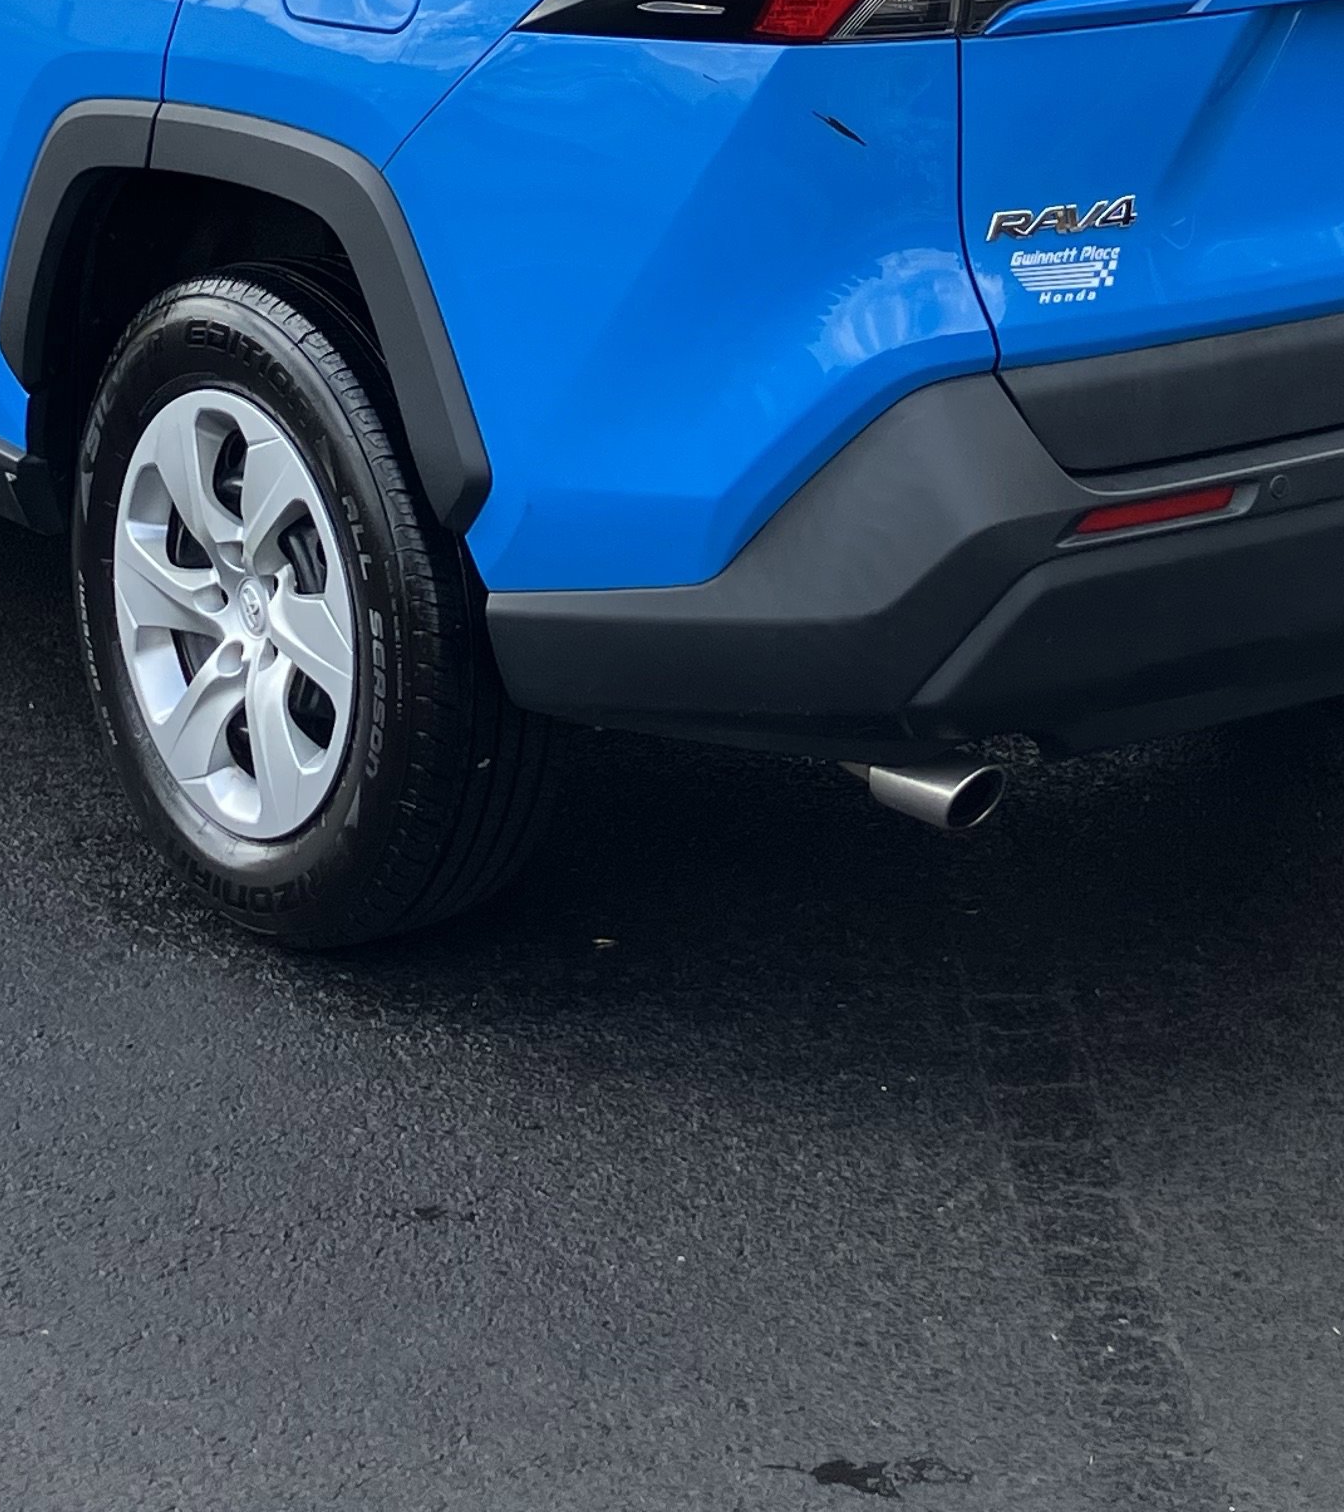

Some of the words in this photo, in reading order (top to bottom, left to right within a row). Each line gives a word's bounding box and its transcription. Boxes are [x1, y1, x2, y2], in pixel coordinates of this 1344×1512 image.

[985, 194, 1138, 242] RAV4
[1009, 247, 1078, 267] Gwinnett
[1079, 245, 1121, 262] Place
[1038, 289, 1097, 305] Honda
[342, 496, 371, 581] ALL
